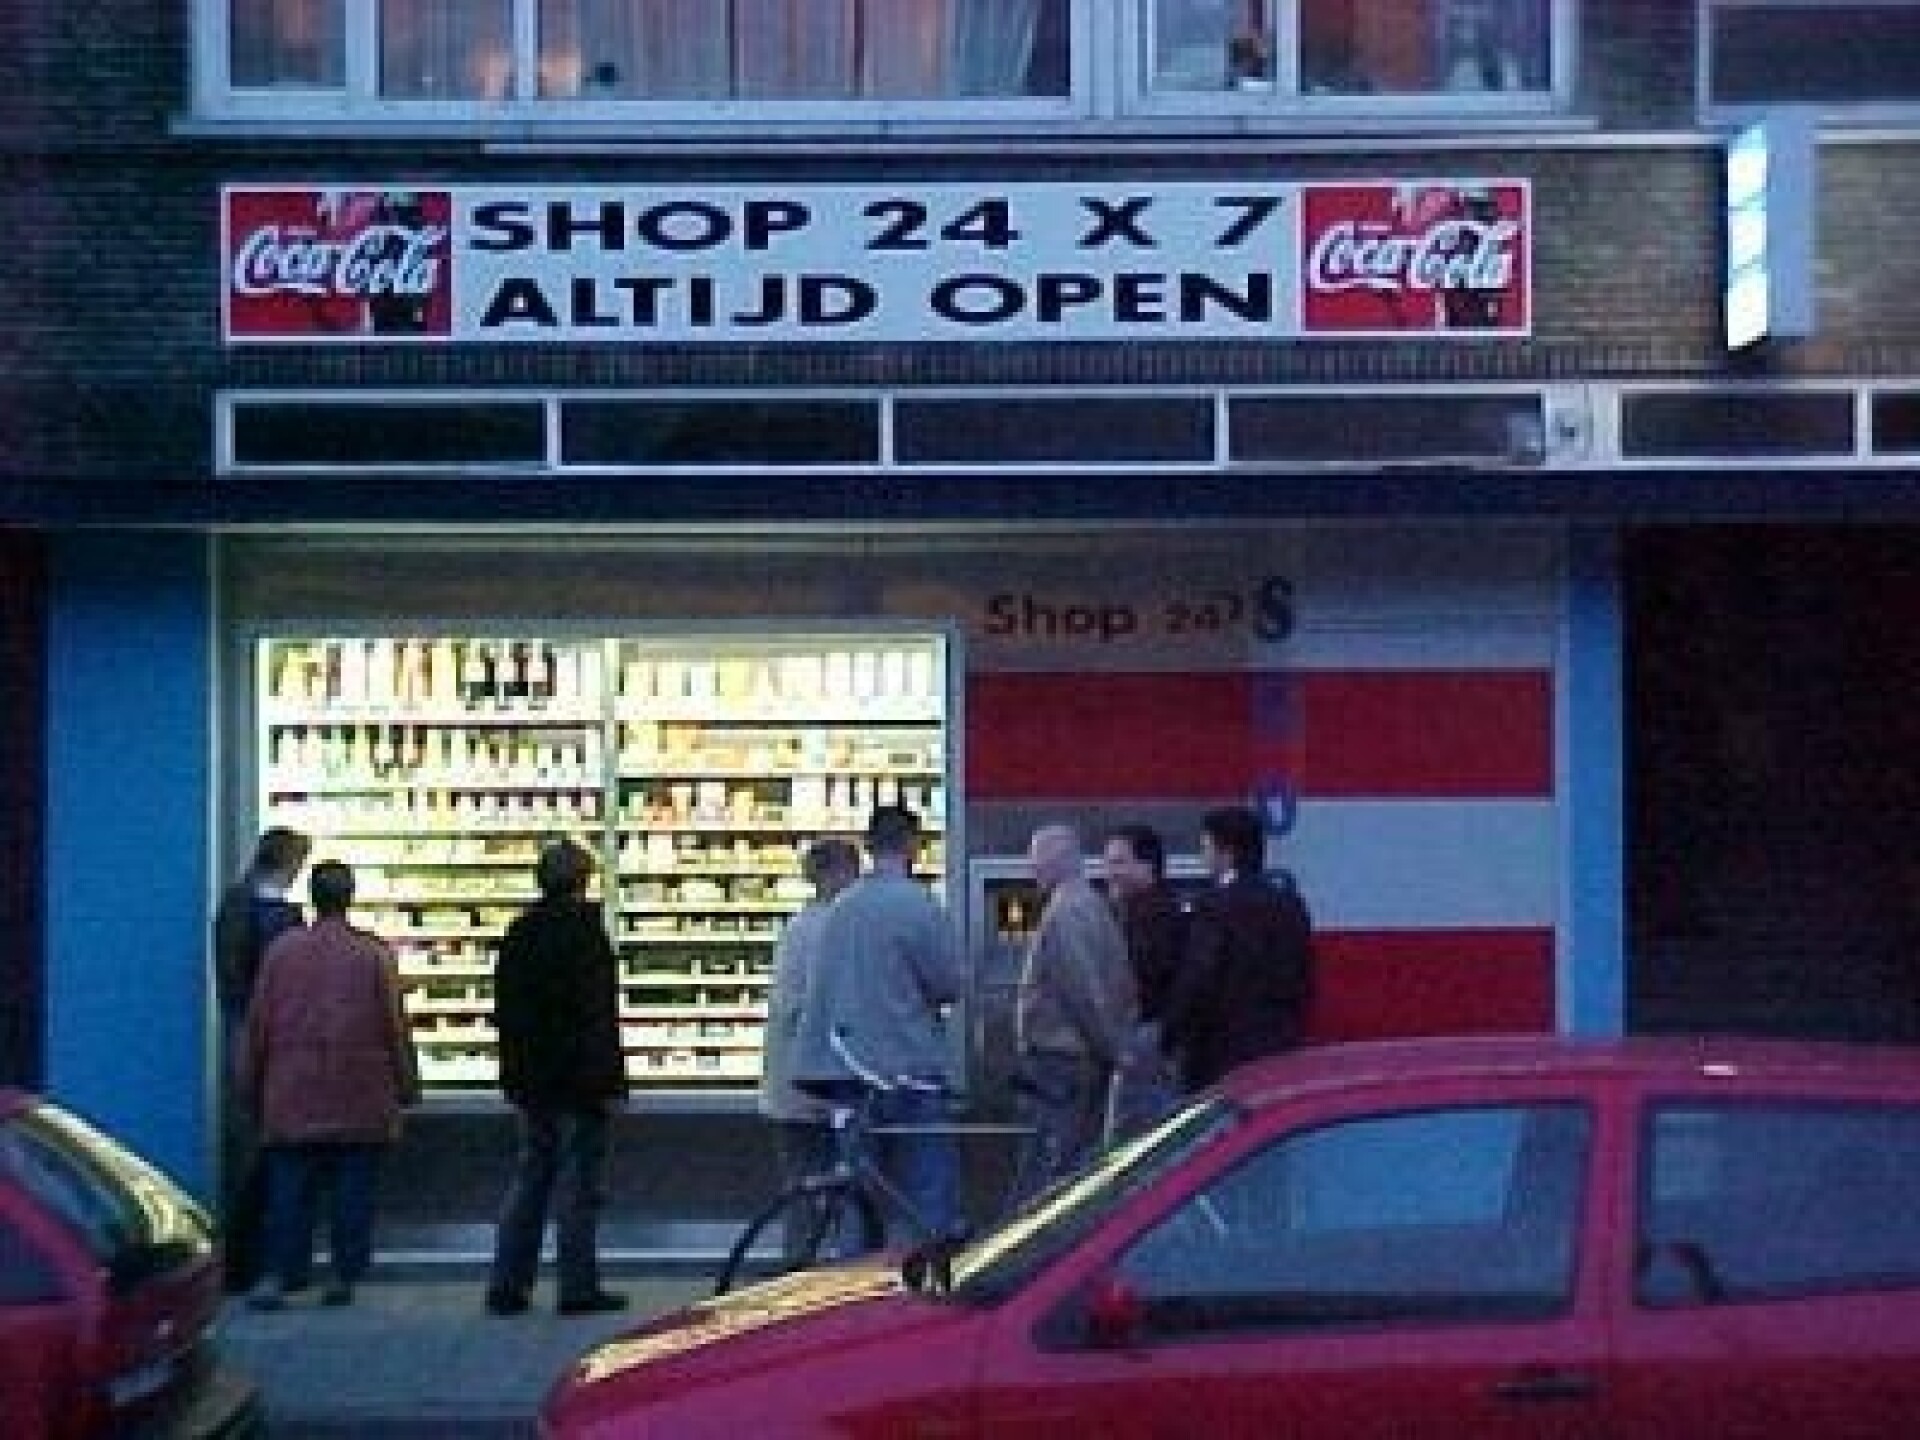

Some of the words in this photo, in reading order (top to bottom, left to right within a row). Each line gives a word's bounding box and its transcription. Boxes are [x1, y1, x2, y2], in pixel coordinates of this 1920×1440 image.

[470, 201, 811, 250] SHOP
[864, 197, 1021, 250] 24
[1080, 197, 1157, 249] X
[1215, 197, 1282, 245] 7
[480, 274, 878, 327] ALTIJD
[931, 273, 1272, 326] OPEN
[984, 594, 1138, 643] Shop
